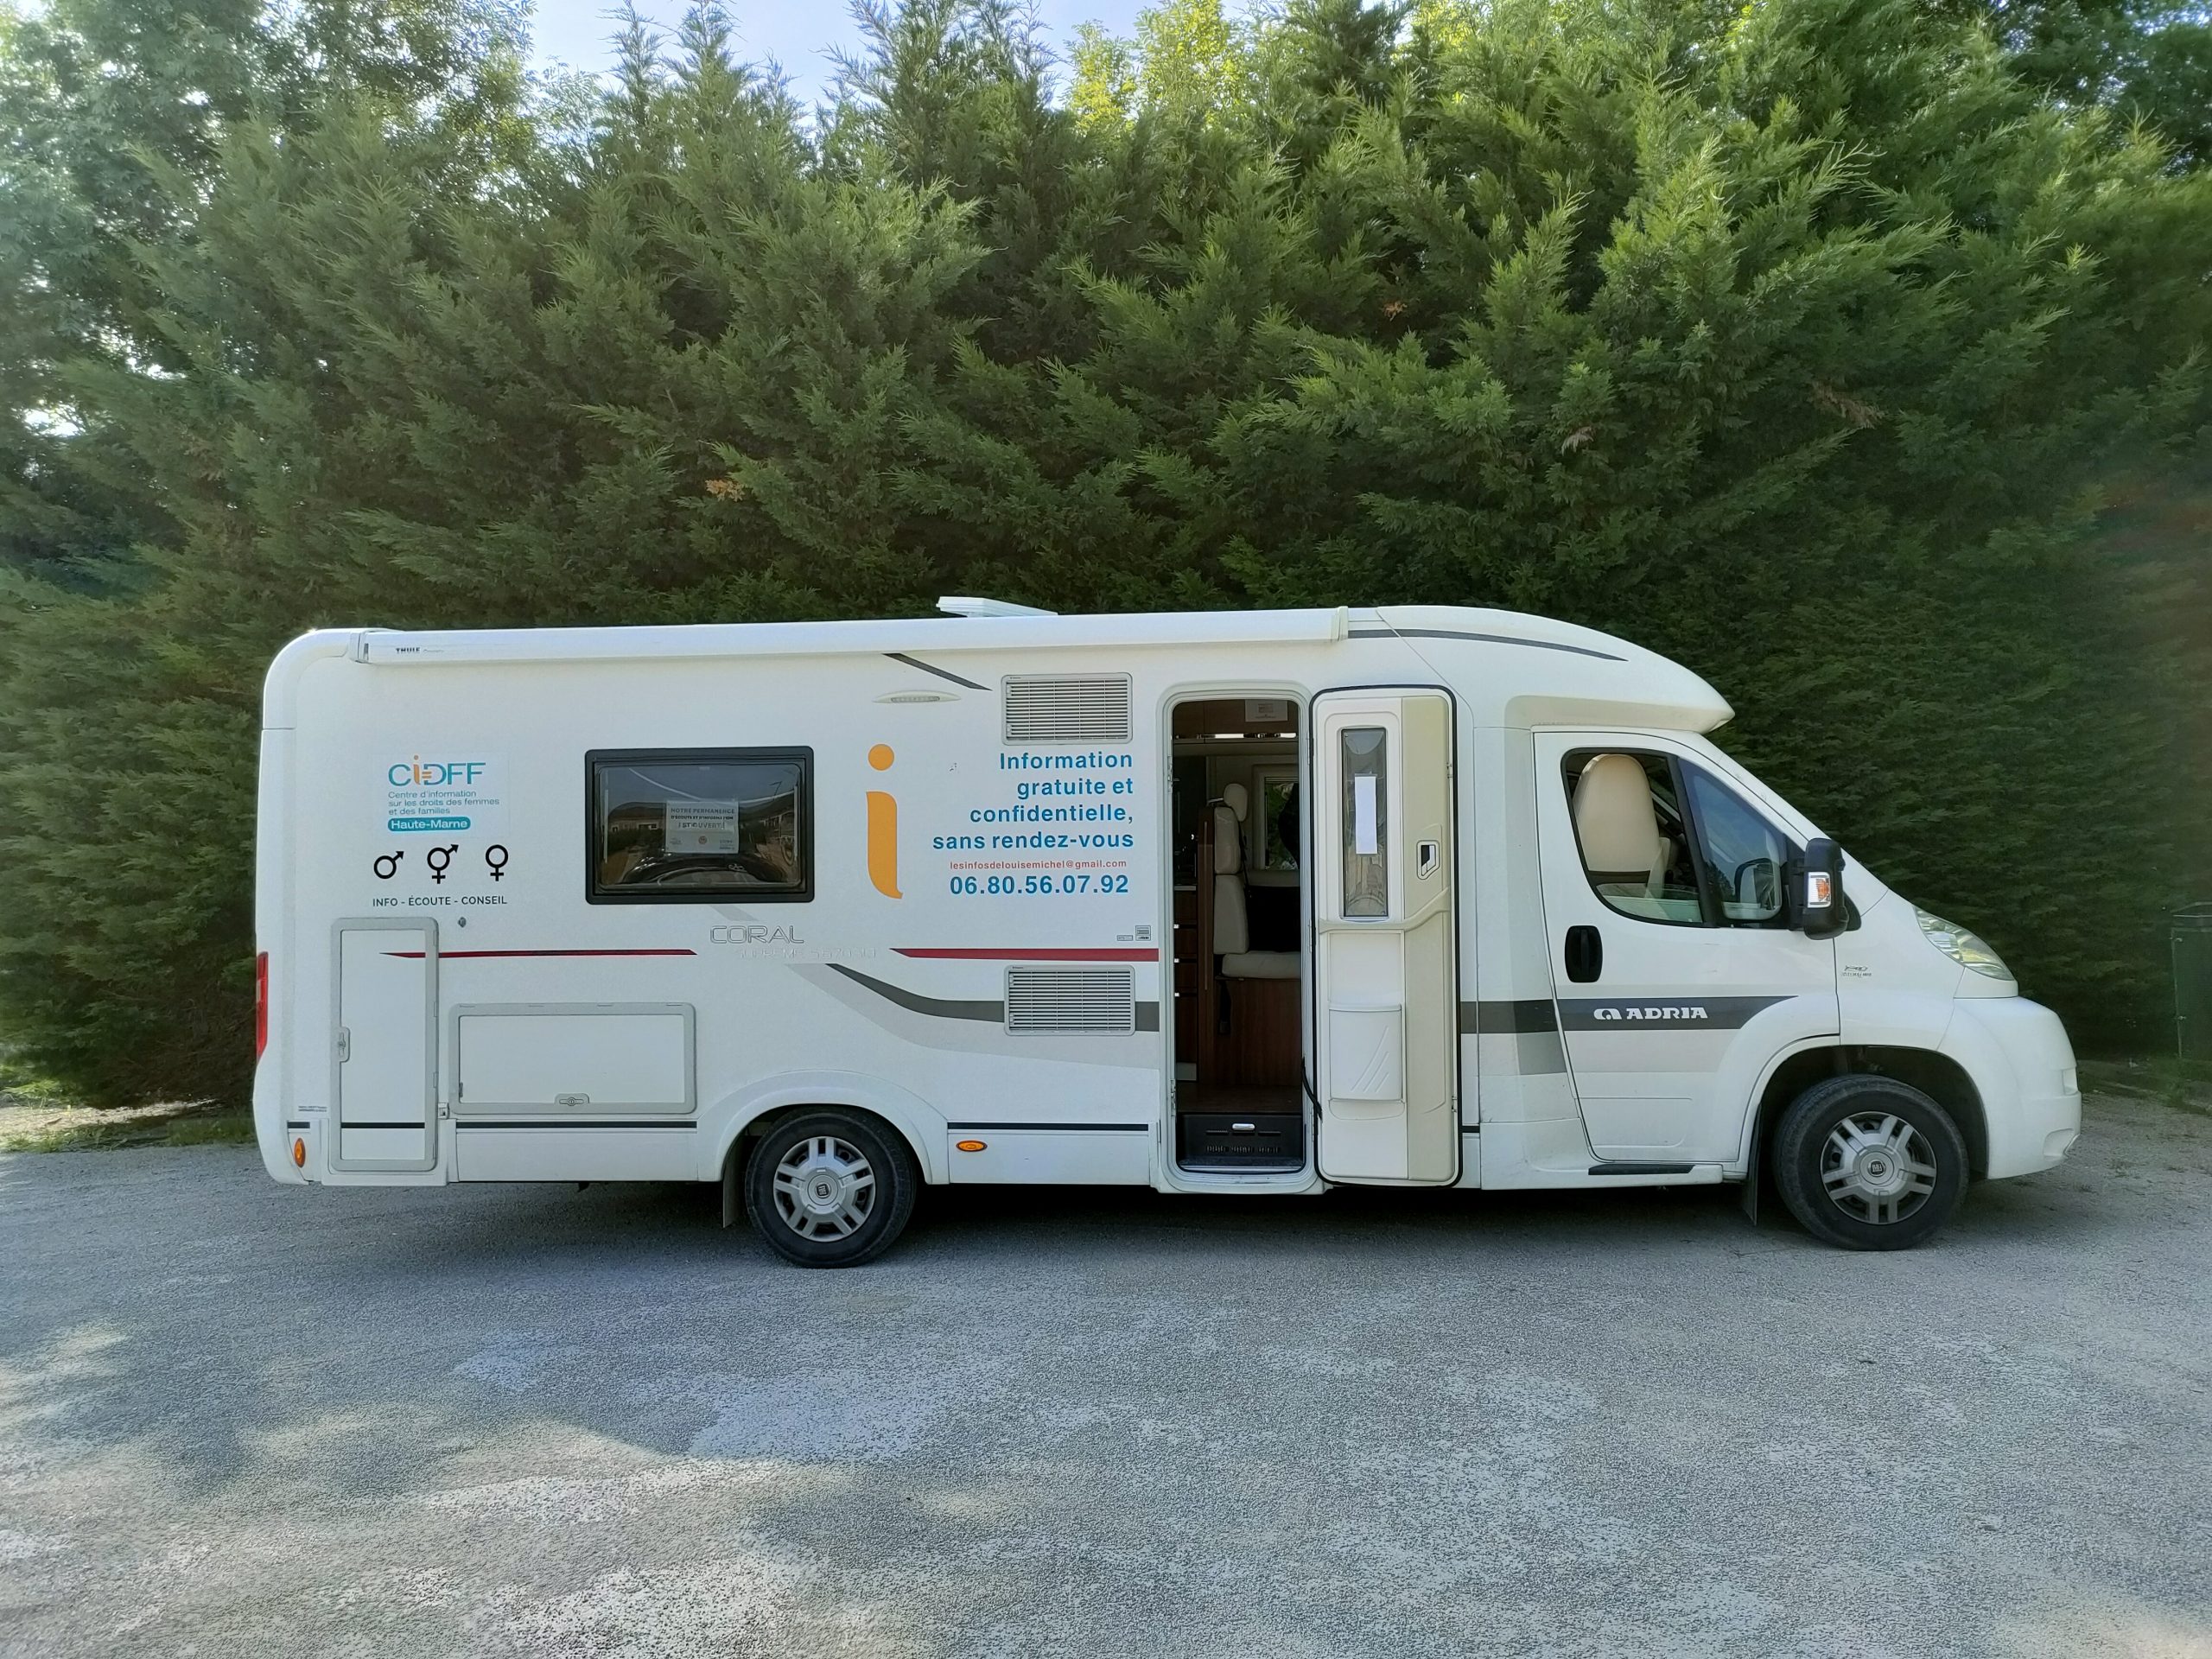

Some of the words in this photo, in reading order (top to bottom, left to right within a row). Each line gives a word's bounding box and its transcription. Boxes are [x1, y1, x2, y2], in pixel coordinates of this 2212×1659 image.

[1000, 751, 1133, 769] Information
[388, 791, 417, 799] Centre
[420, 790, 477, 798] d'information
[1017, 778, 1106, 800] gratuite
[1112, 778, 1134, 794] et
[969, 804, 1134, 824] confidentielle,
[391, 819, 468, 830] Haute-Marne
[932, 835, 986, 849] sans
[992, 831, 1134, 849] rendez-vous
[950, 860, 1127, 870] lesinfosdelouisemichel@gmail.com
[950, 874, 1128, 895] 06.80.56.07.92
[372, 898, 398, 907] INFO
[409, 895, 451, 906] ÉCOUTE
[461, 896, 508, 905] CONSEIL
[709, 925, 804, 944] CORAL
[1626, 1007, 1708, 1020] ADRIA
